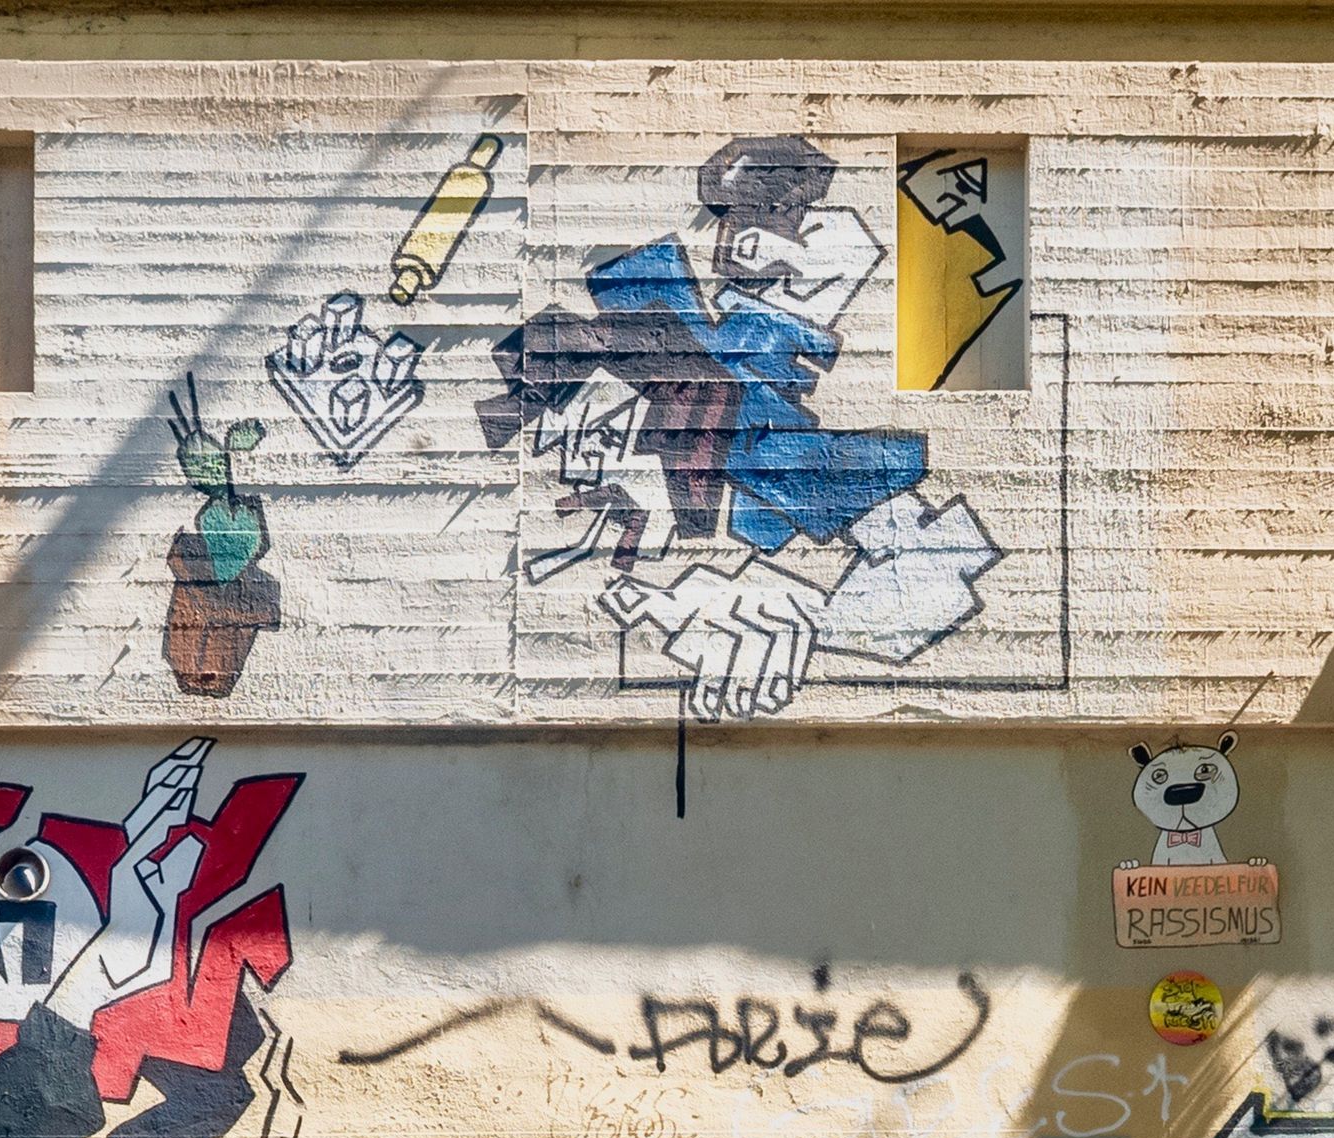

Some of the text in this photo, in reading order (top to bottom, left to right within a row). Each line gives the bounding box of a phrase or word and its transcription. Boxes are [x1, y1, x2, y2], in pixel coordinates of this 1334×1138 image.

[1126, 876, 1167, 898] KEIN
[1172, 875, 1236, 898] VEEDEL
[1127, 906, 1274, 939] RASSISMUS
